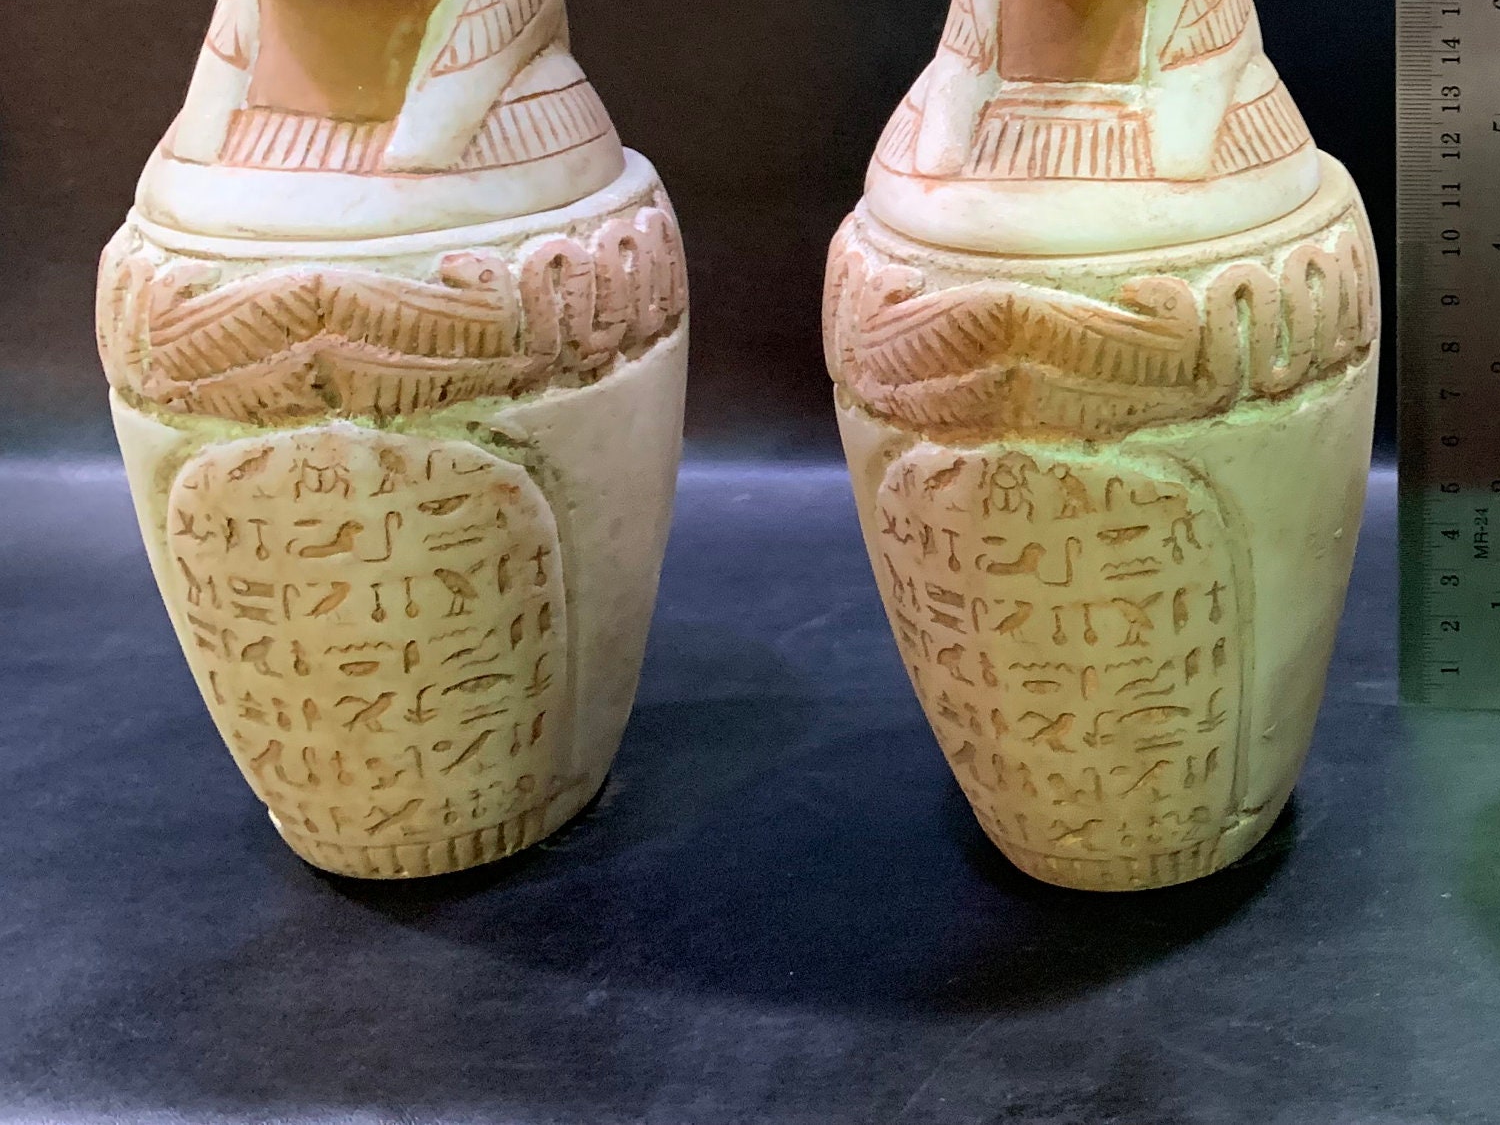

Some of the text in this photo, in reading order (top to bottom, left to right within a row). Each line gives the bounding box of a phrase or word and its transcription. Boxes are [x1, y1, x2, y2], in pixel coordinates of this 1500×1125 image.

[1441, 36, 1461, 65] 14
[1440, 85, 1461, 113] 13
[1440, 132, 1461, 160] 12
[1441, 182, 1461, 209] 11
[1440, 229, 1461, 257] 10
[1440, 294, 1461, 307] 9
[1440, 341, 1461, 354] 8
[1440, 388, 1461, 401] 7
[1440, 435, 1461, 448] 6
[1440, 482, 1461, 495] 5
[1440, 529, 1461, 541] 4
[1473, 507, 1490, 560] MR-24
[1440, 574, 1461, 587] 3
[1440, 620, 1461, 633] 2
[1440, 666, 1461, 675] 1
